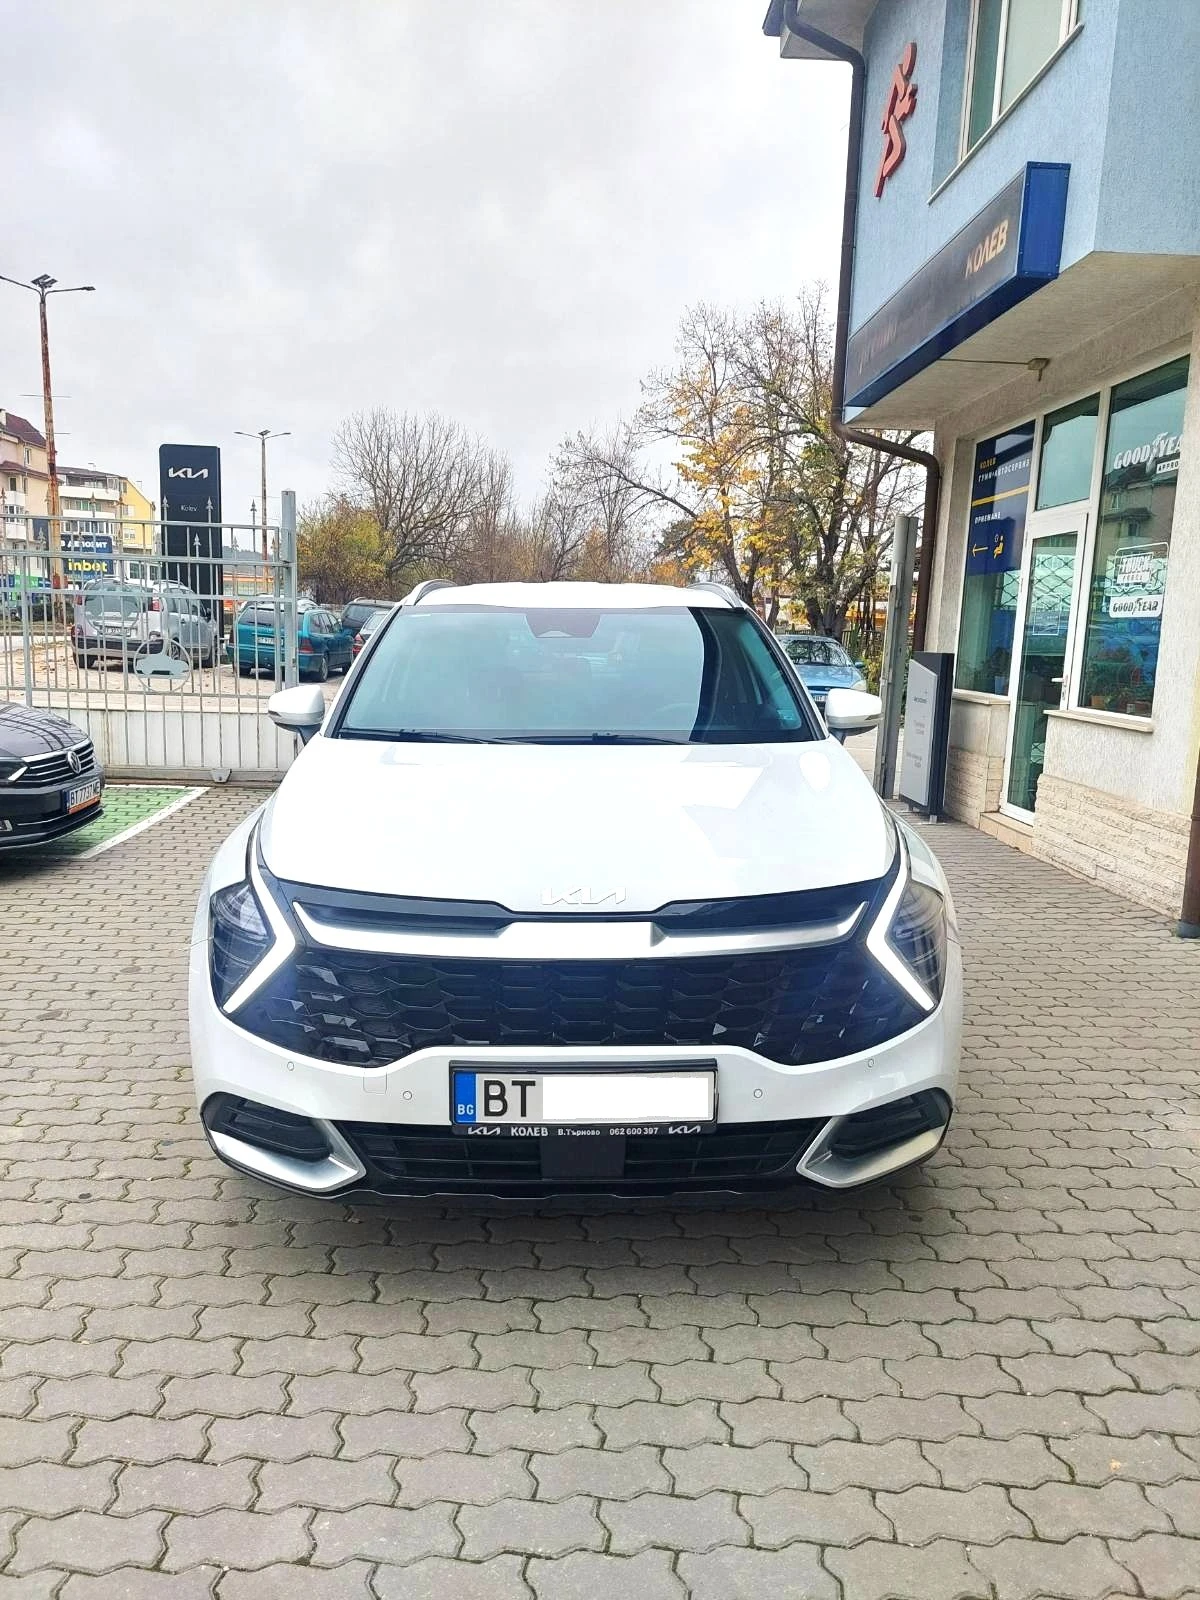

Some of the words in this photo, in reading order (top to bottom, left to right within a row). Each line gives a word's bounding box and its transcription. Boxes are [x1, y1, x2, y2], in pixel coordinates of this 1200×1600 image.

[68, 559, 108, 572] inbet
[1112, 598, 1159, 615] GOODYEAR
[457, 1104, 474, 1115] BG
[511, 1127, 549, 1137] КОЛЕВ
[609, 1128, 625, 1136] 062
[626, 1127, 642, 1135] 600
